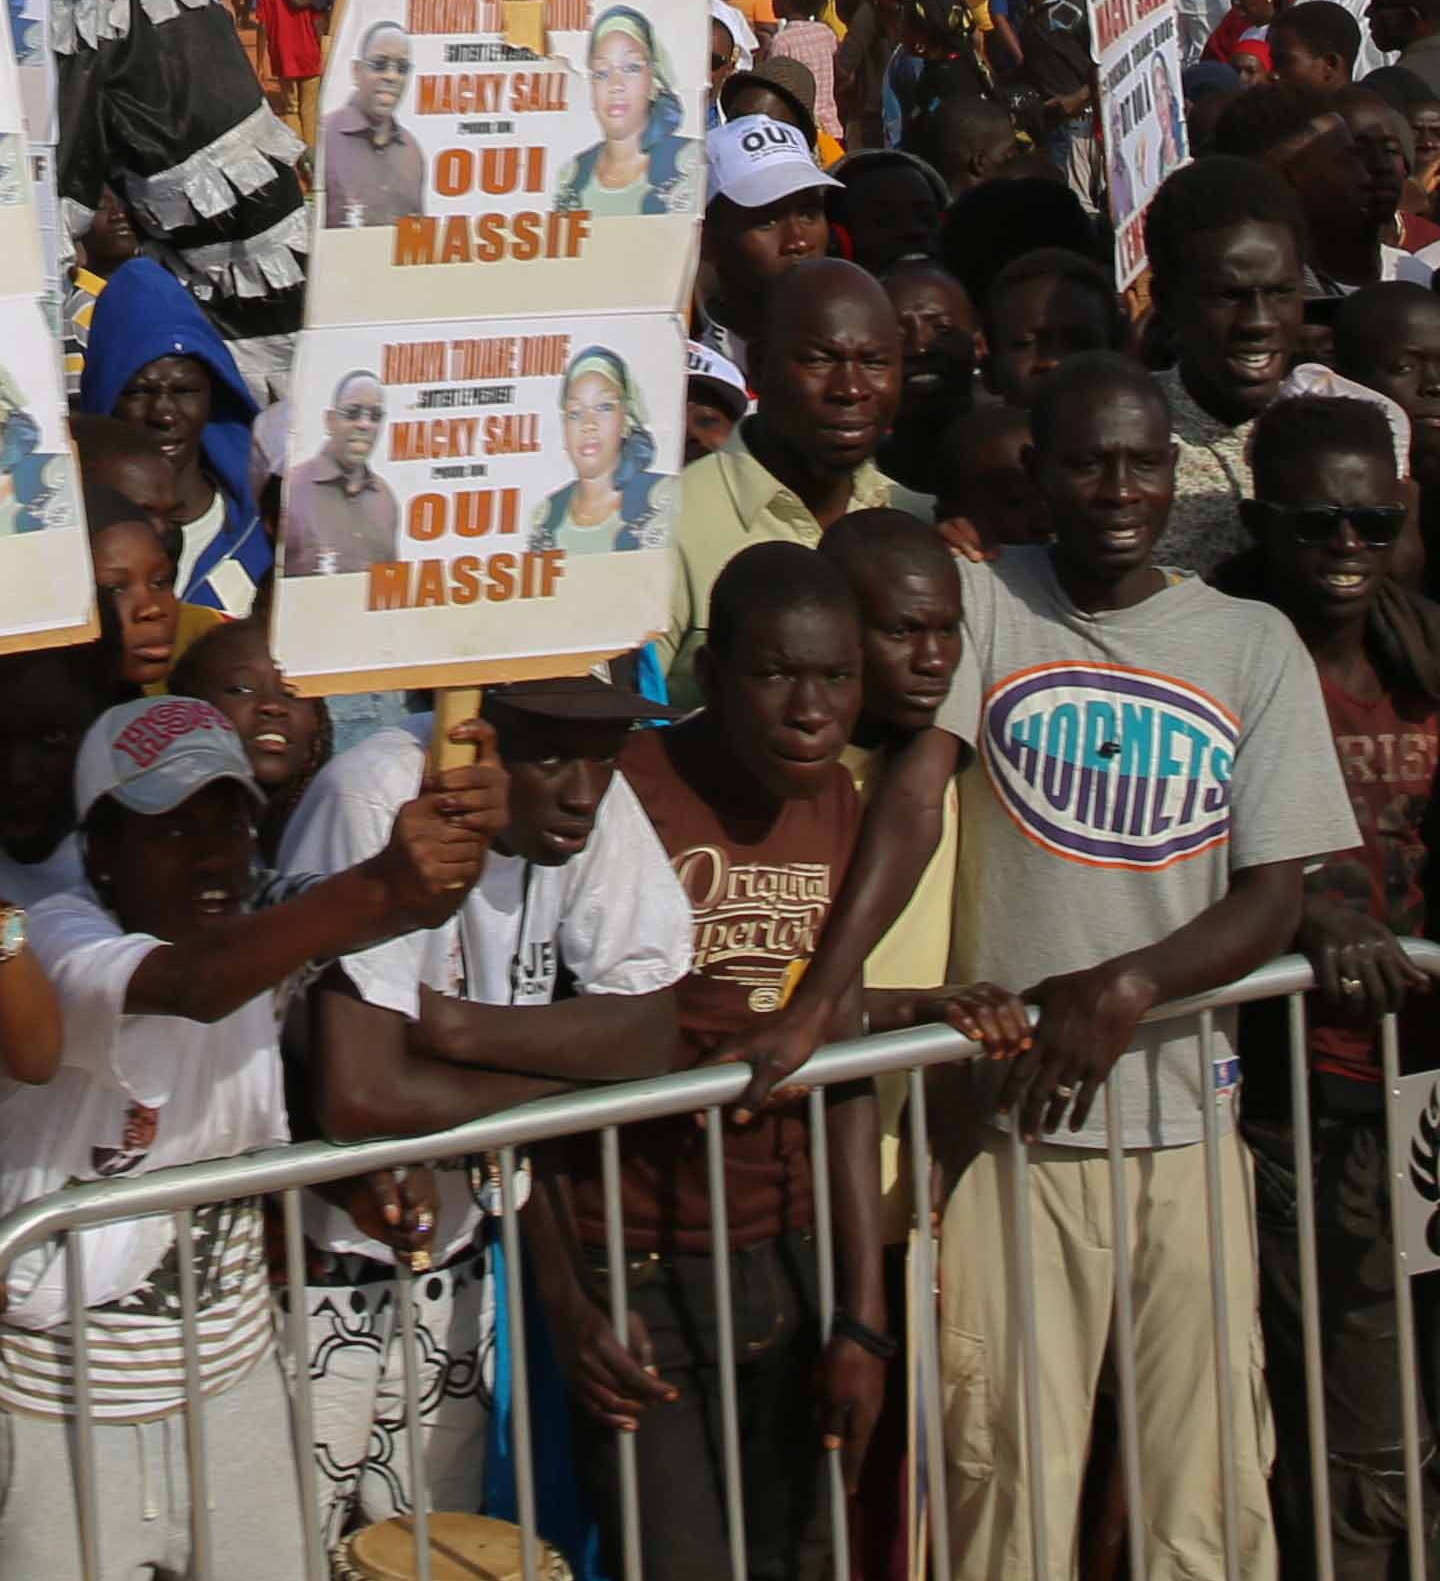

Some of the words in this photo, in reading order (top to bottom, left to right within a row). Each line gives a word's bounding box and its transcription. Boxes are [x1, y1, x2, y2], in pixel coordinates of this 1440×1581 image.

[416, 72, 506, 116] MACKY
[511, 71, 568, 112] SALL
[742, 127, 798, 151] OUI
[433, 147, 547, 197] OUI
[391, 209, 592, 266] MASSIF
[388, 416, 480, 461] MACKY
[482, 413, 540, 455] SALL
[407, 488, 521, 542] OUI
[368, 548, 568, 611] MASSIF
[1010, 700, 1232, 837] HORNETS
